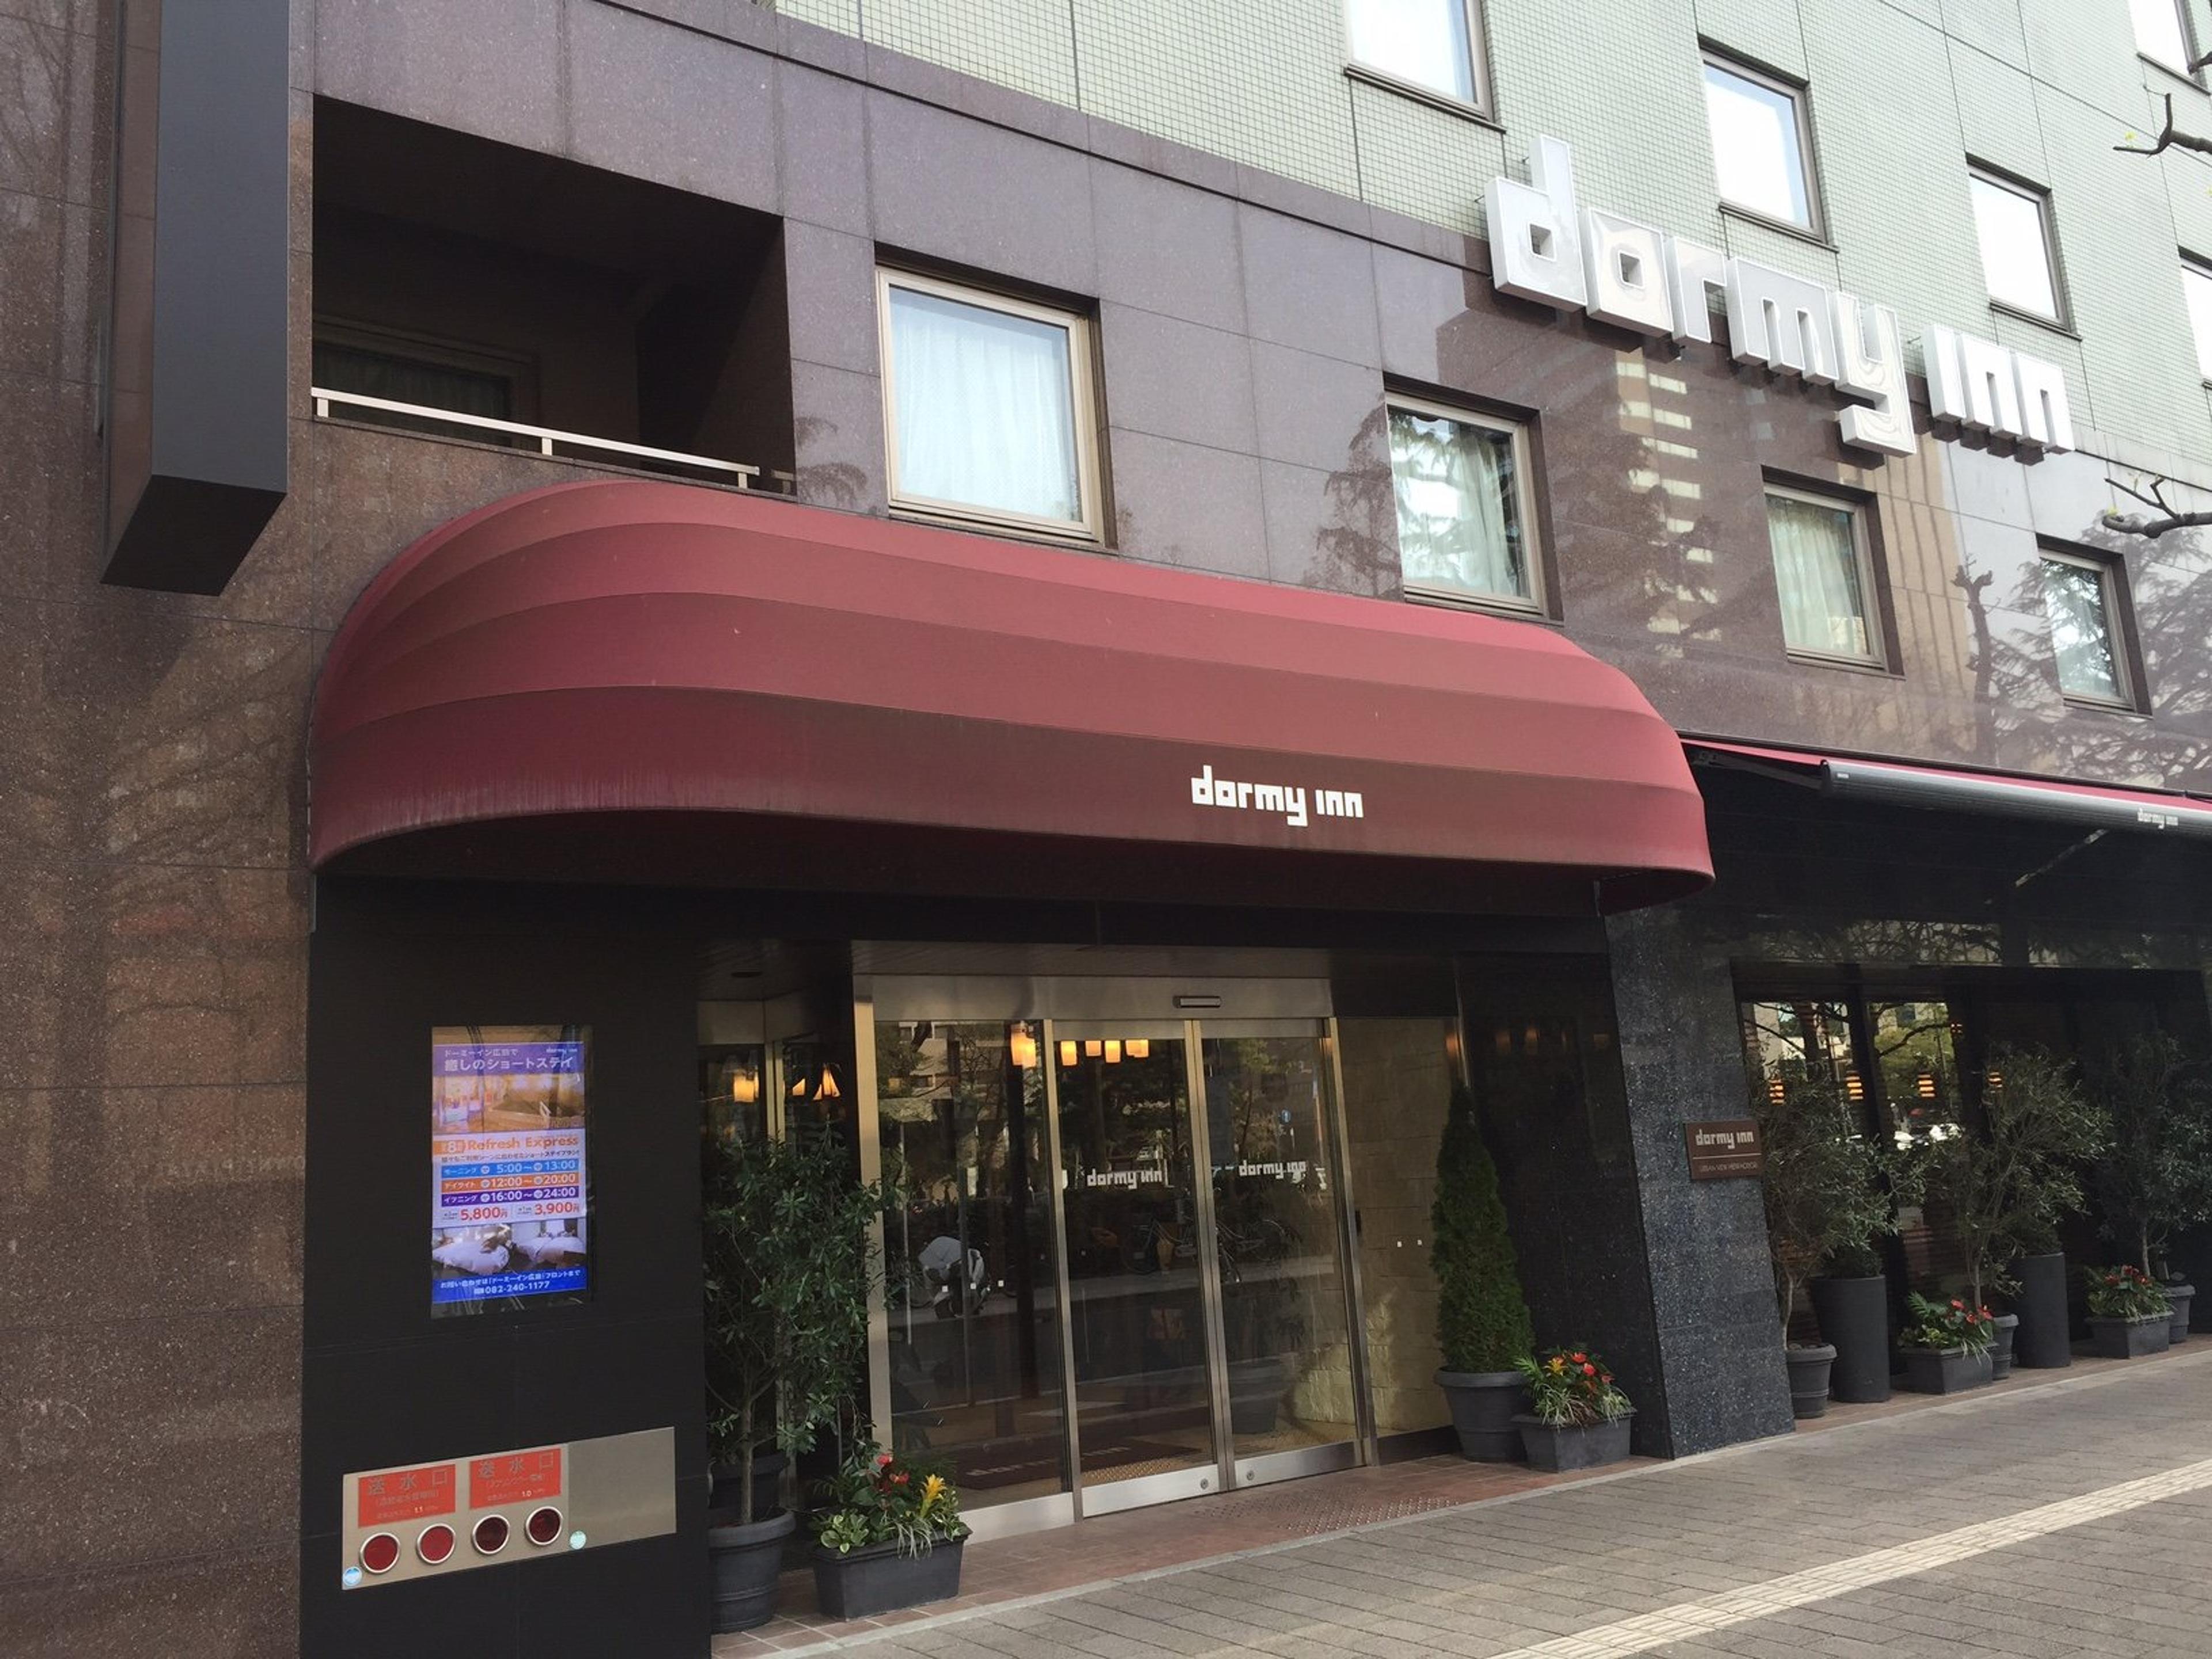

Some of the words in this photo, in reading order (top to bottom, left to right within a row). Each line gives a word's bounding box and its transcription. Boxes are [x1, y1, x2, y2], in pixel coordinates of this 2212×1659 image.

[1484, 134, 1917, 458] dormy
[1923, 323, 2075, 454] inn
[1191, 765, 1308, 827] dormy
[1315, 789, 1364, 818] inn
[467, 1137, 520, 1150] Refresh
[525, 1136, 579, 1150] Express
[1695, 1128, 1735, 1150] dormy
[1736, 1131, 1755, 1143] inn
[1087, 1168, 1137, 1190] dormy
[1238, 1160, 1284, 1180] dormy
[543, 1187, 576, 1199] 24:00
